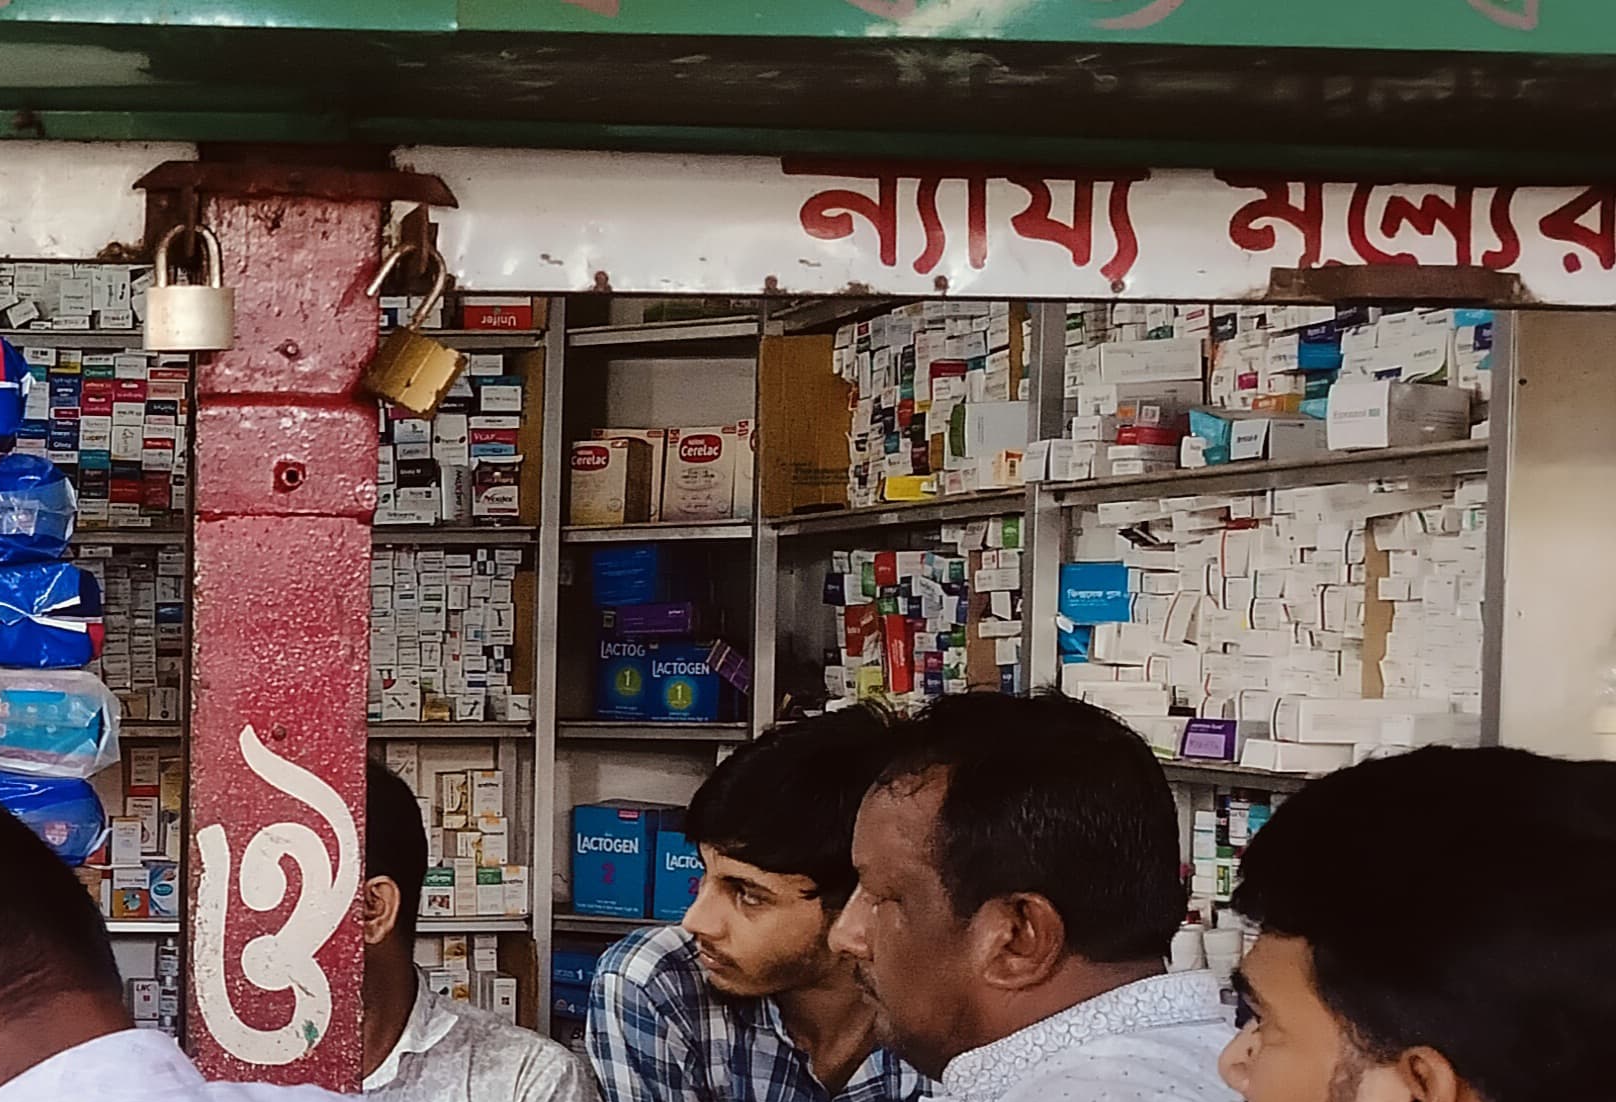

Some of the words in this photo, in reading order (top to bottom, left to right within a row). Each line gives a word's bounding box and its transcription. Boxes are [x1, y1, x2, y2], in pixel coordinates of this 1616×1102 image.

[1214, 163, 1616, 274] মল্যের
[482, 313, 517, 328] Unifer
[680, 442, 720, 458] Cerelac
[571, 453, 607, 466] Cerelac
[600, 640, 646, 660] LACTOG
[652, 660, 710, 678] LACTOGEN
[576, 832, 640, 854] LACTOGEN
[665, 852, 705, 870] LACTO
[601, 863, 616, 884] 2
